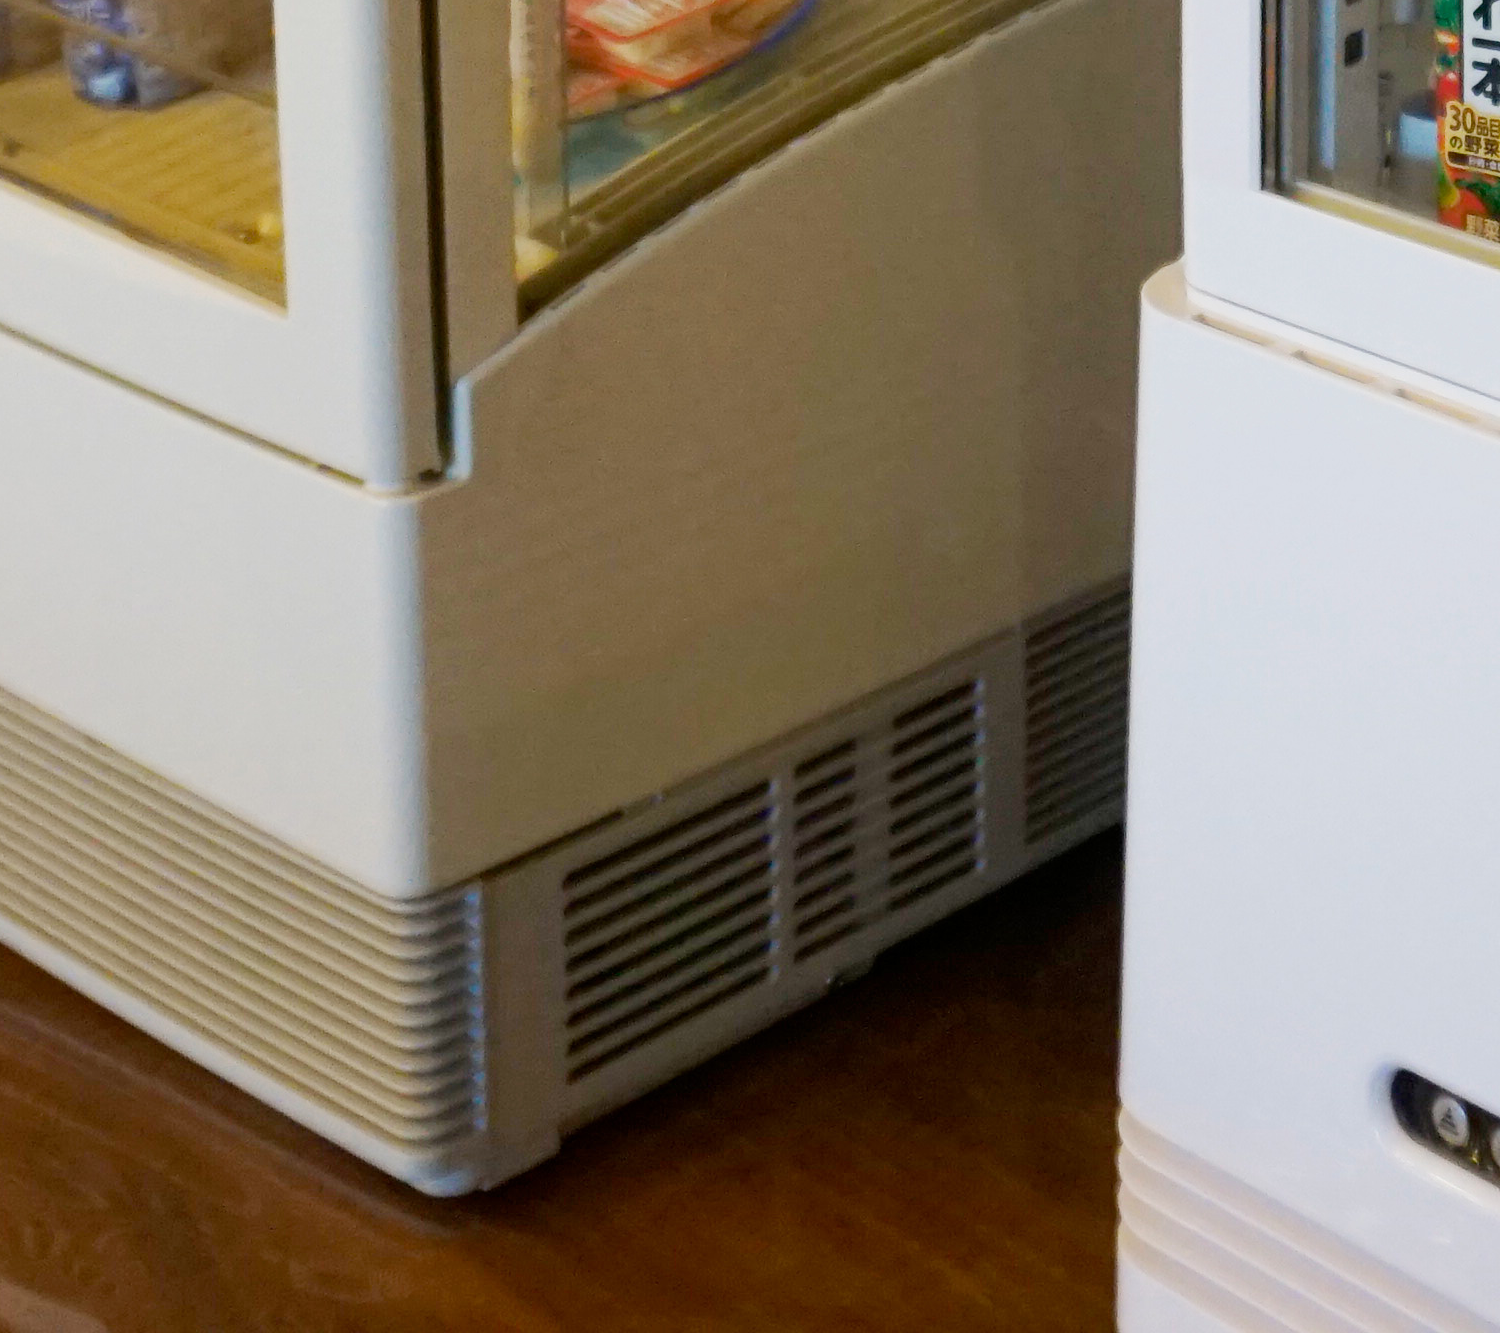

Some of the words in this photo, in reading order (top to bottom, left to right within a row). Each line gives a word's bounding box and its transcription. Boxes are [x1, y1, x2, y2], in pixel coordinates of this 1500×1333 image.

[1449, 104, 1500, 140] 30品目
[1449, 135, 1500, 159] の野菜
